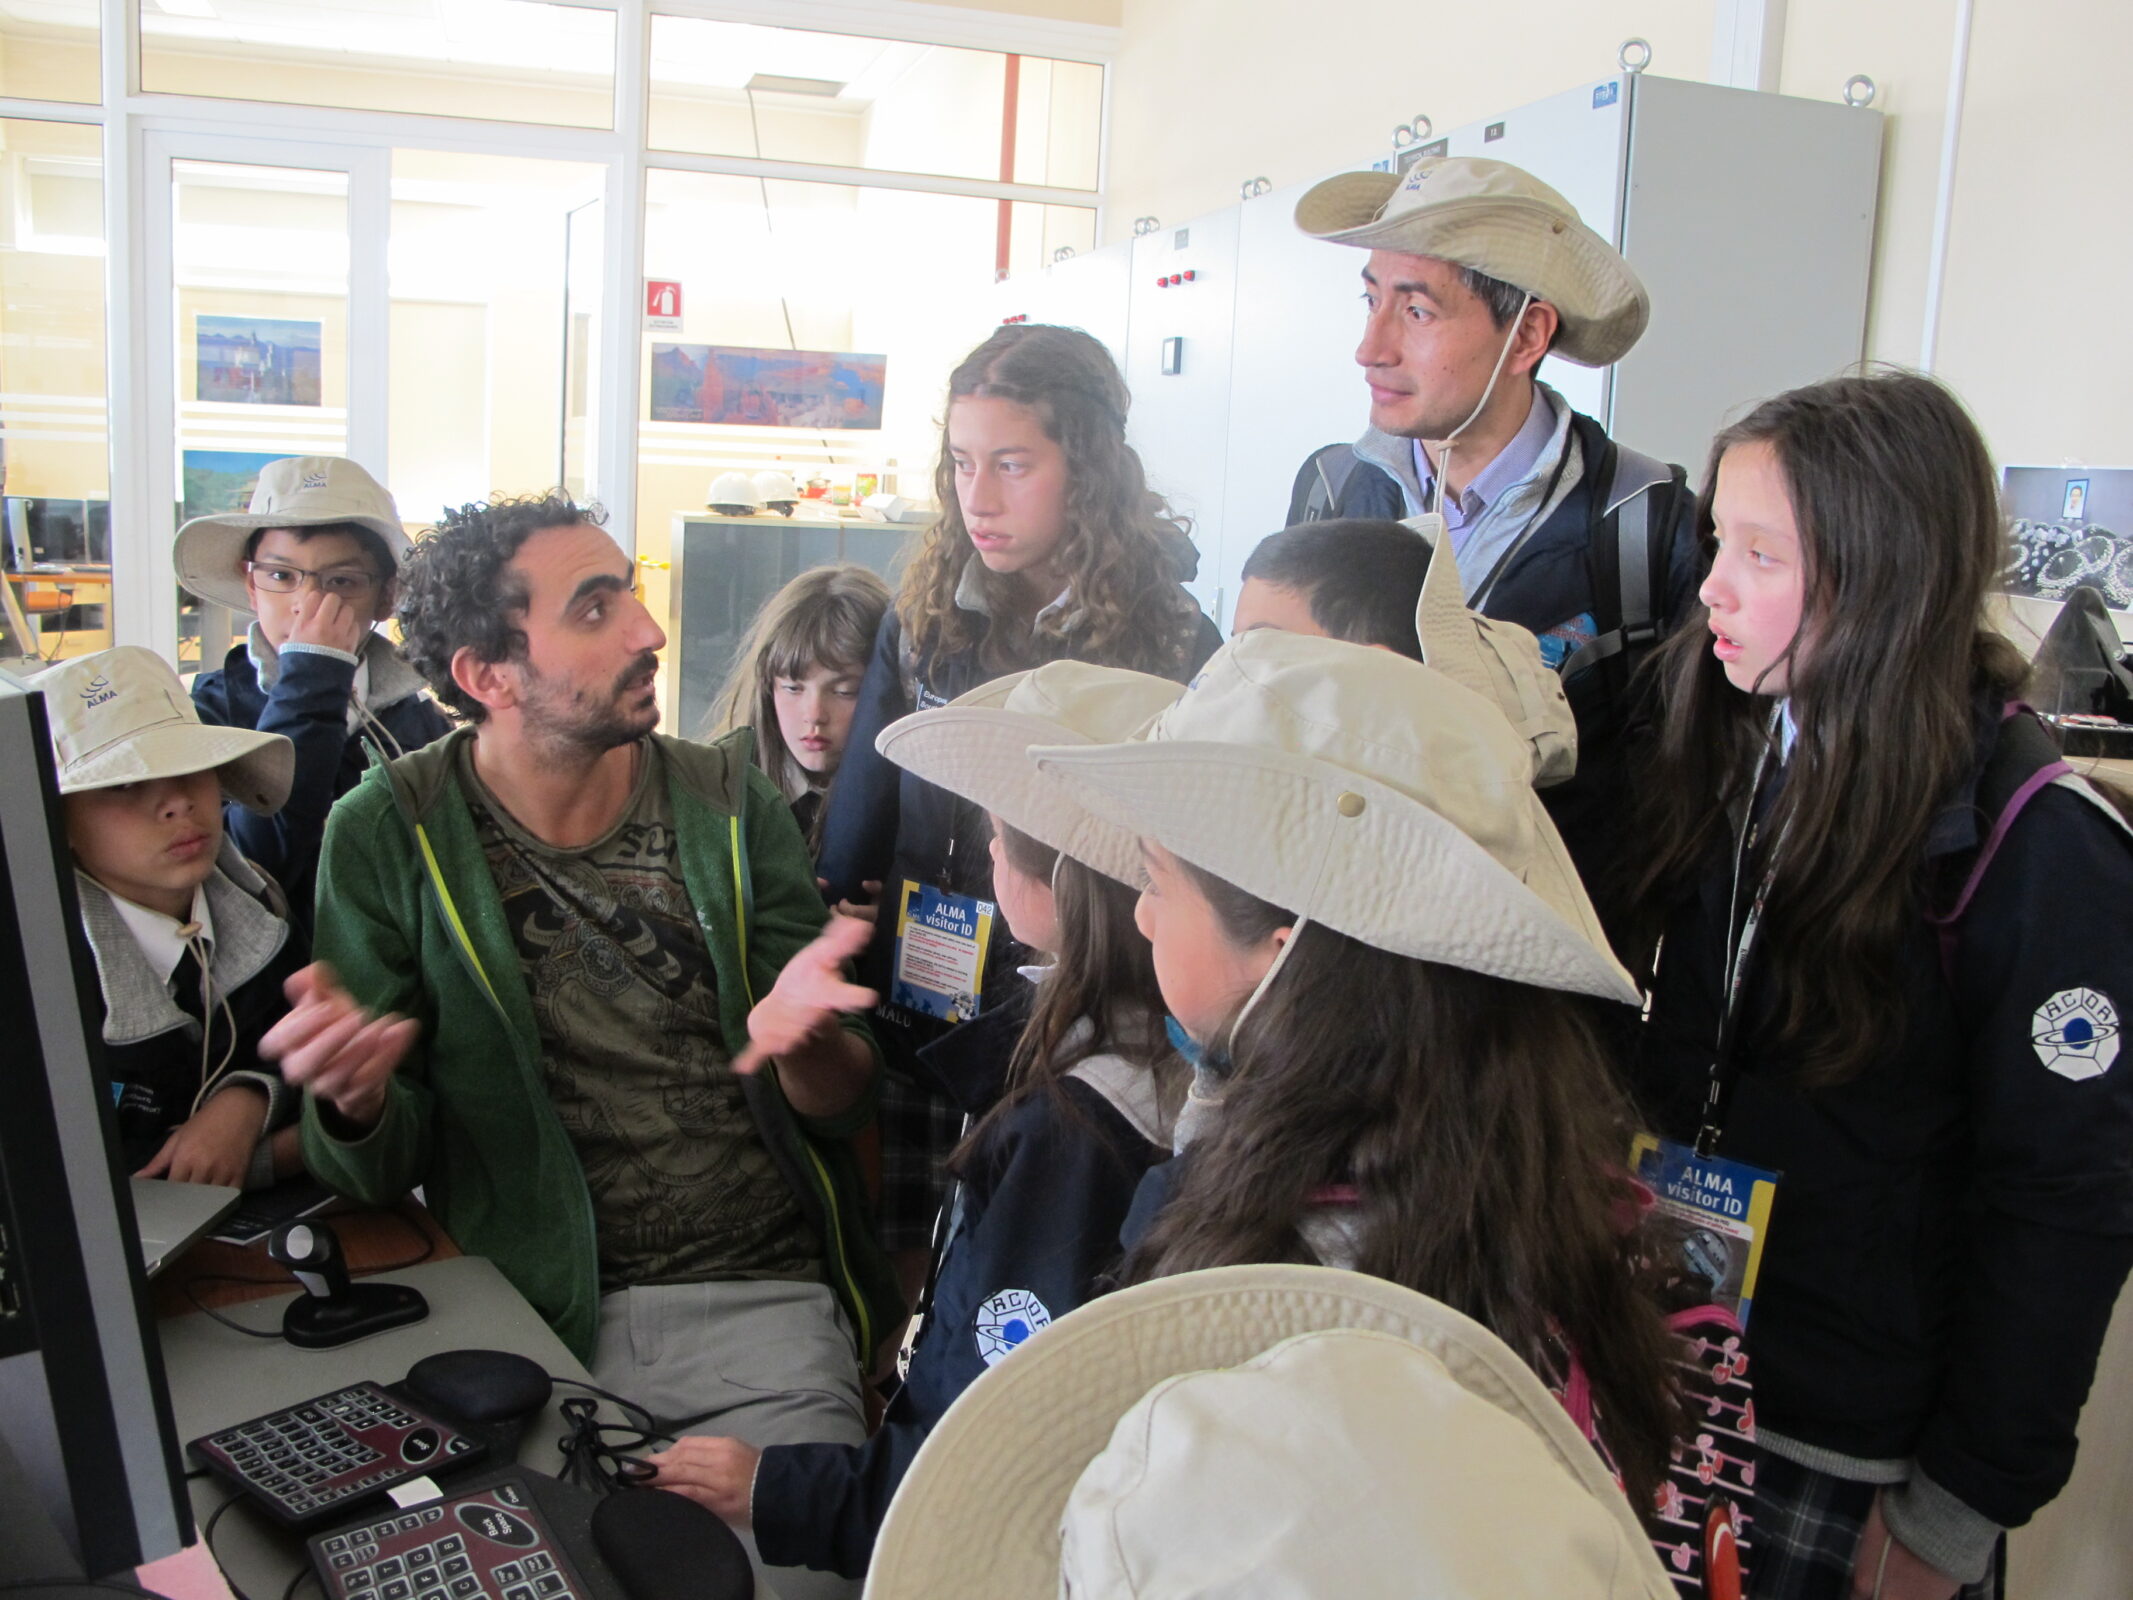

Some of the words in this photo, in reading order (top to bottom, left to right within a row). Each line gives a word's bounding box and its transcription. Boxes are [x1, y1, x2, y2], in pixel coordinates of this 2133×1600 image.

[303, 481, 327, 489] ALMA
[87, 690, 118, 709] ALMA
[935, 902, 966, 921] ALMA
[926, 914, 960, 932] visitor
[961, 923, 973, 936] ID
[1681, 1166, 1733, 1195] ALMA
[1667, 1181, 1720, 1209] visitor
[1723, 1197, 1743, 1215] ID
[482, 1517, 499, 1537] Back
[495, 1512, 512, 1535] Space
[443, 1542, 454, 1550] B
[414, 1553, 425, 1561] G
[383, 1566, 393, 1574] T
[450, 1562, 461, 1571] V
[420, 1575, 432, 1583] F
[389, 1585, 401, 1595] R
[459, 1581, 470, 1590] C
